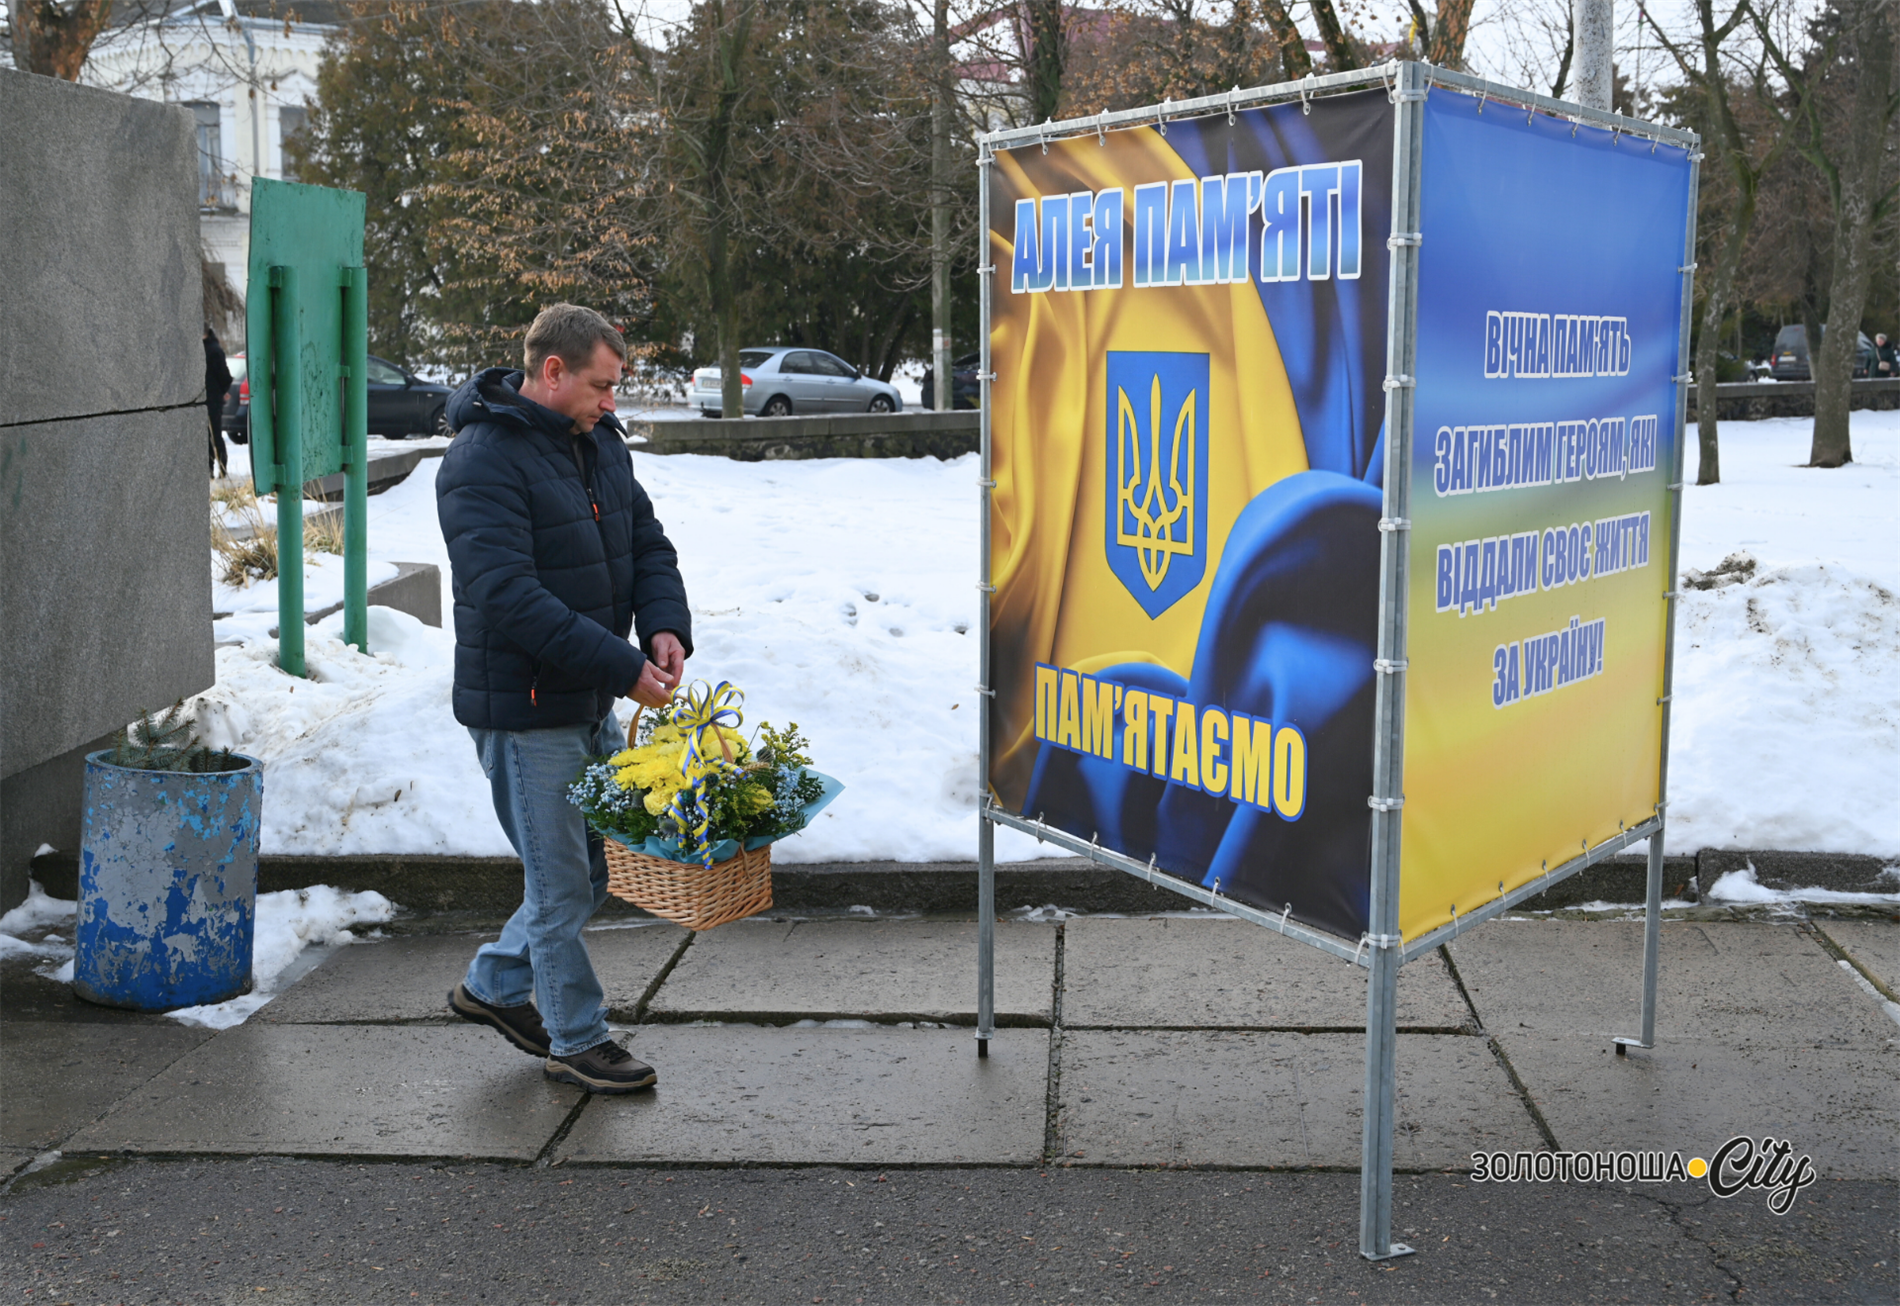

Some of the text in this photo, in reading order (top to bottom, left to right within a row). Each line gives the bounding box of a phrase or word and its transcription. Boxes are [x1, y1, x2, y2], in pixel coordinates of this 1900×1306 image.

[1011, 160, 1362, 293] АЛЕЯ ПАМ’ЯТІ
[1484, 310, 1550, 378] ВІЧНА
[1434, 414, 1657, 497] ЗАГИБЛИМ ГЕРОЯМ, ЯКІ
[1436, 510, 1650, 618] ВІДДАЛИ СВОЄ ЖИТТЯ
[1492, 614, 1605, 710] ЗА УКРАЇНУ!
[1034, 661, 1307, 822] ПАМ’ЯТАЄМО
